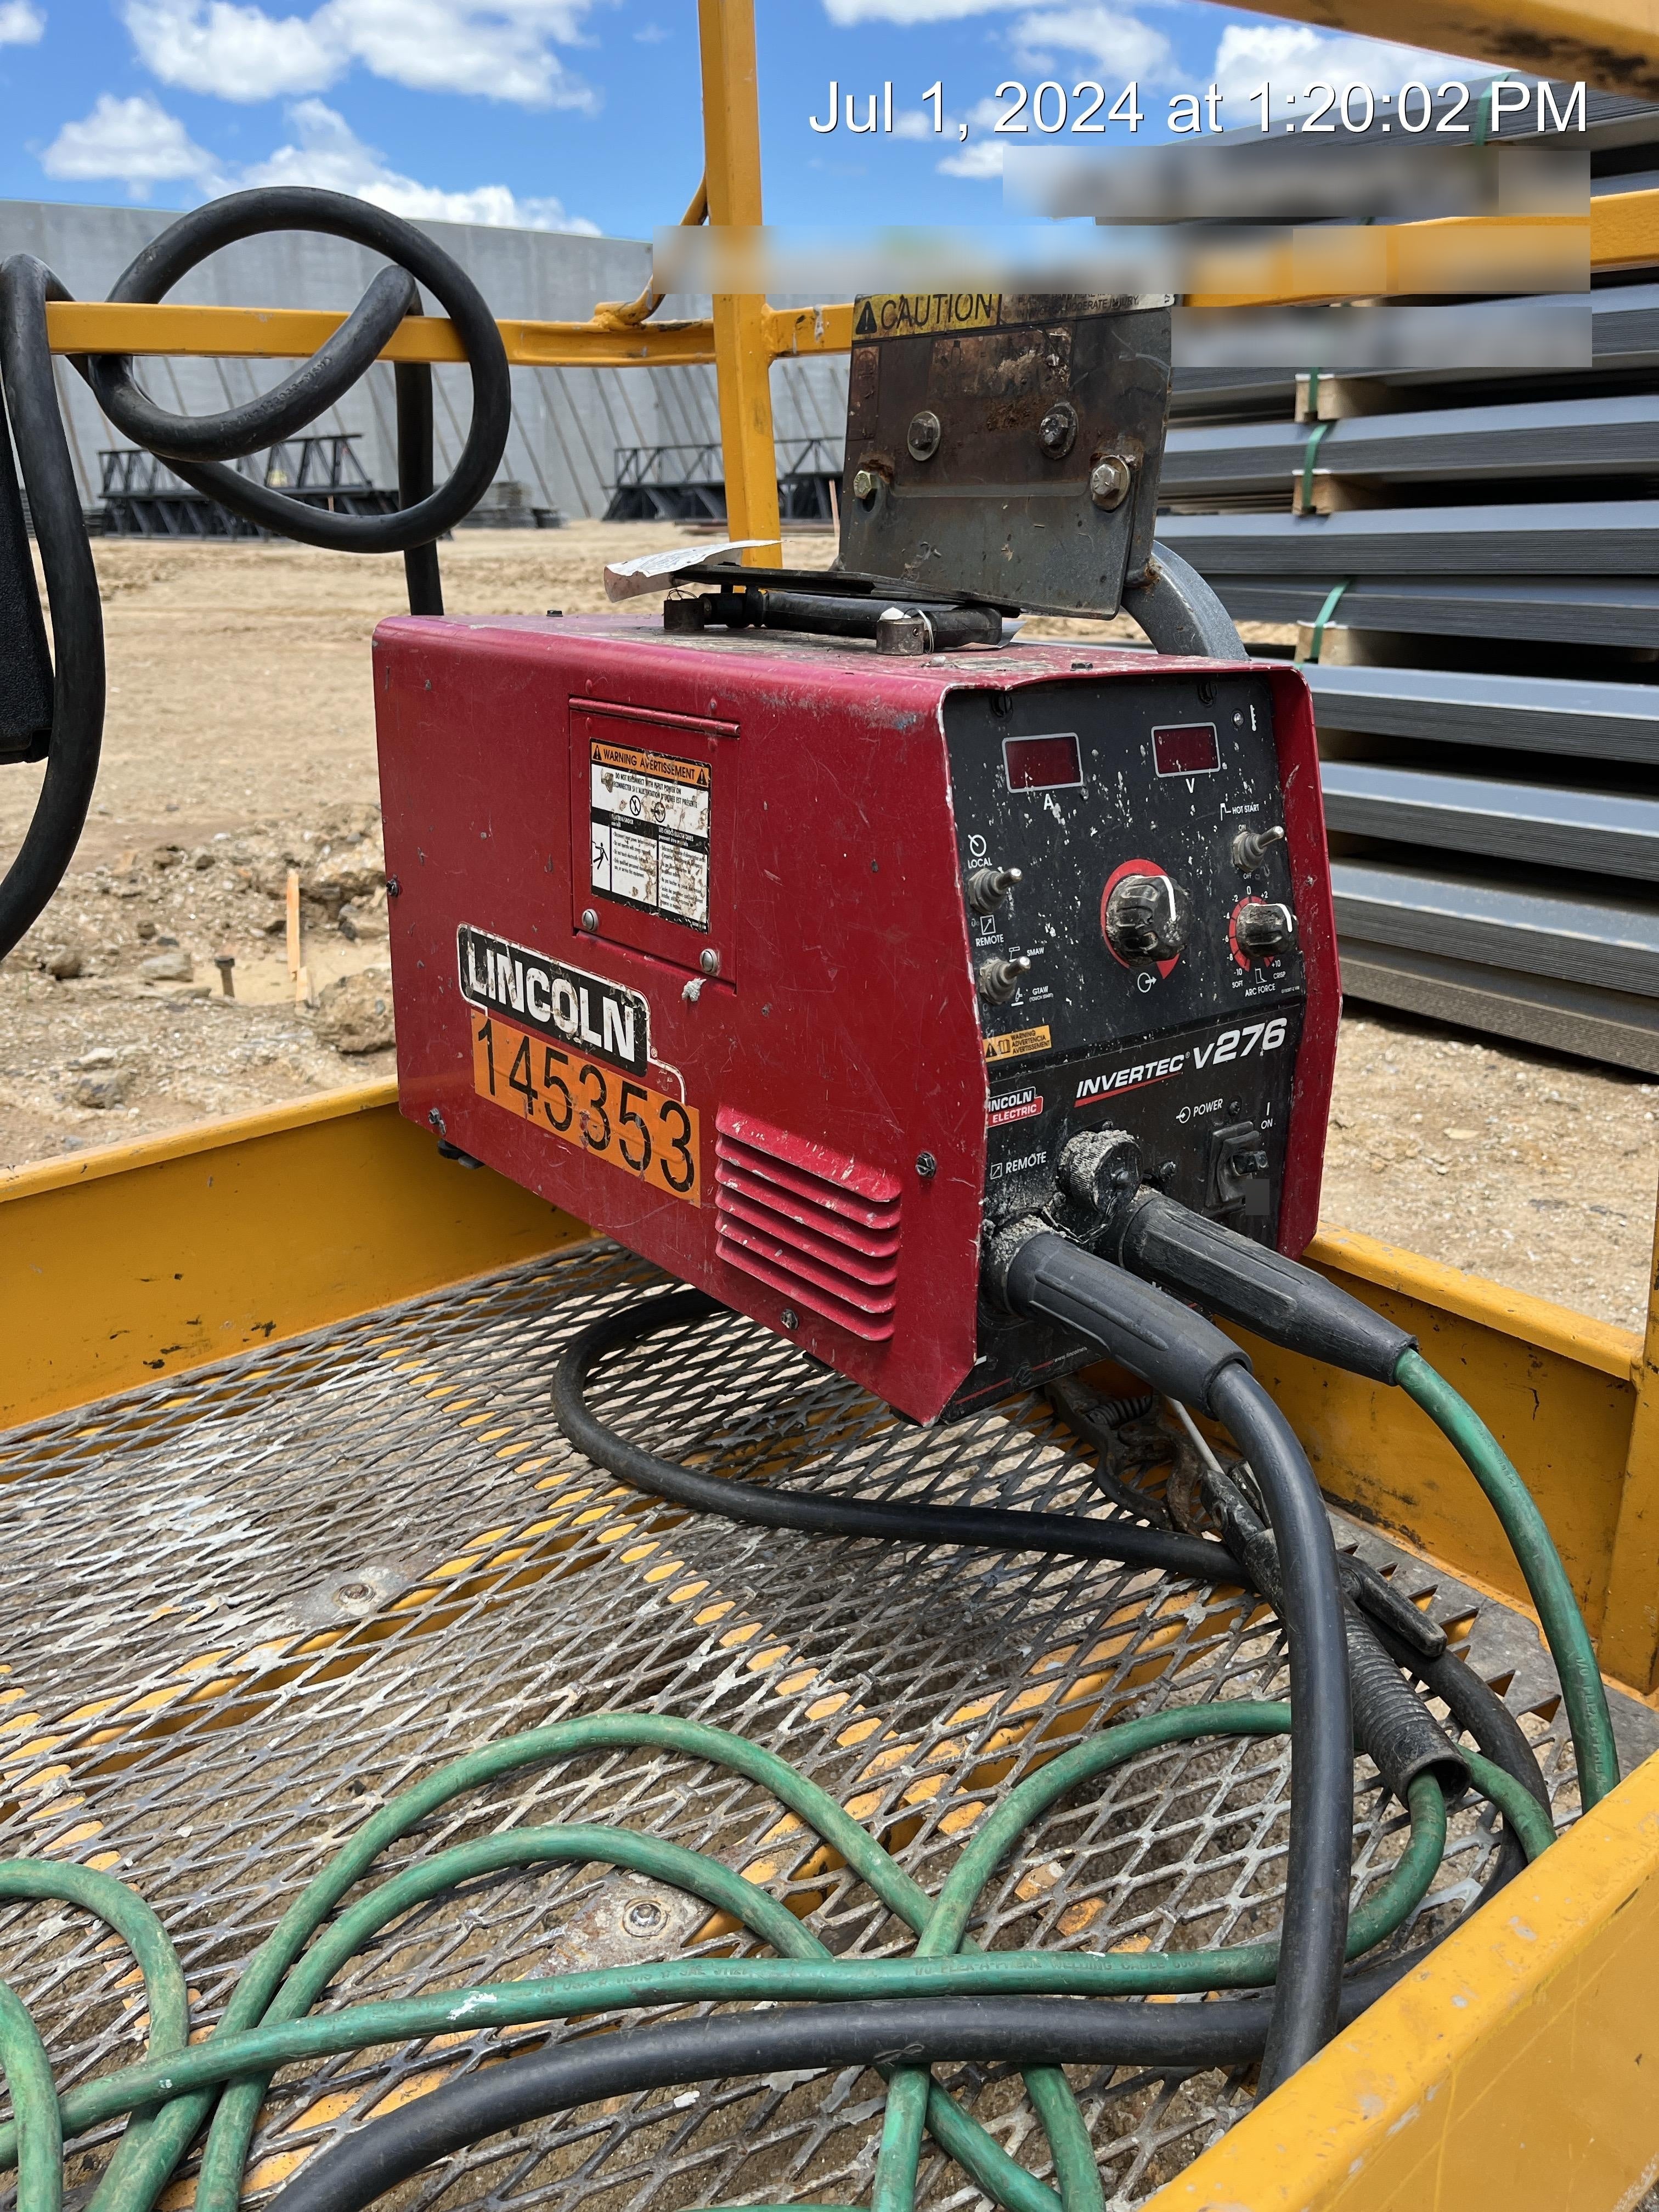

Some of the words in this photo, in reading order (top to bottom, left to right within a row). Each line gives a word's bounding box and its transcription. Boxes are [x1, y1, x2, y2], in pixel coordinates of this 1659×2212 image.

[881, 294, 992, 330] CAUTION
[603, 748, 637, 766] WARNING
[640, 757, 695, 780] AVERTISSEMENT
[1186, 778, 1195, 794] V
[1043, 793, 1055, 810] A
[1232, 806, 1244, 815] HOT
[1244, 804, 1260, 813] START
[967, 857, 992, 869] LOCAL
[1246, 885, 1251, 895] 0
[975, 934, 1005, 947] REMOTE
[1026, 947, 1045, 957] SMAW
[1271, 960, 1281, 968] +10
[1234, 968, 1243, 976] -10
[1232, 980, 1243, 989] SOFT
[1273, 970, 1286, 979] CRISP
[1032, 985, 1049, 996] GTAW
[1245, 988, 1257, 997] ARC
[1257, 983, 1276, 994] FORCE
[467, 940, 636, 1063] LINCOLN
[1010, 1030, 1036, 1041] WARNING
[1012, 1034, 1046, 1048] ADVERTENCIA
[1013, 1040, 1051, 1055] AVERTISSEMENT
[1193, 1017, 1288, 1069] V276
[477, 1017, 695, 1193] 145353
[1193, 1098, 1223, 1118] POWER
[992, 1104, 1037, 1124] ELECTRIC
[1261, 1118, 1273, 1130] ON
[1006, 1151, 1047, 1174] REMOTE
[1051, 1961, 1112, 1971] WELDING
[1120, 1961, 1165, 1971] CABLE
